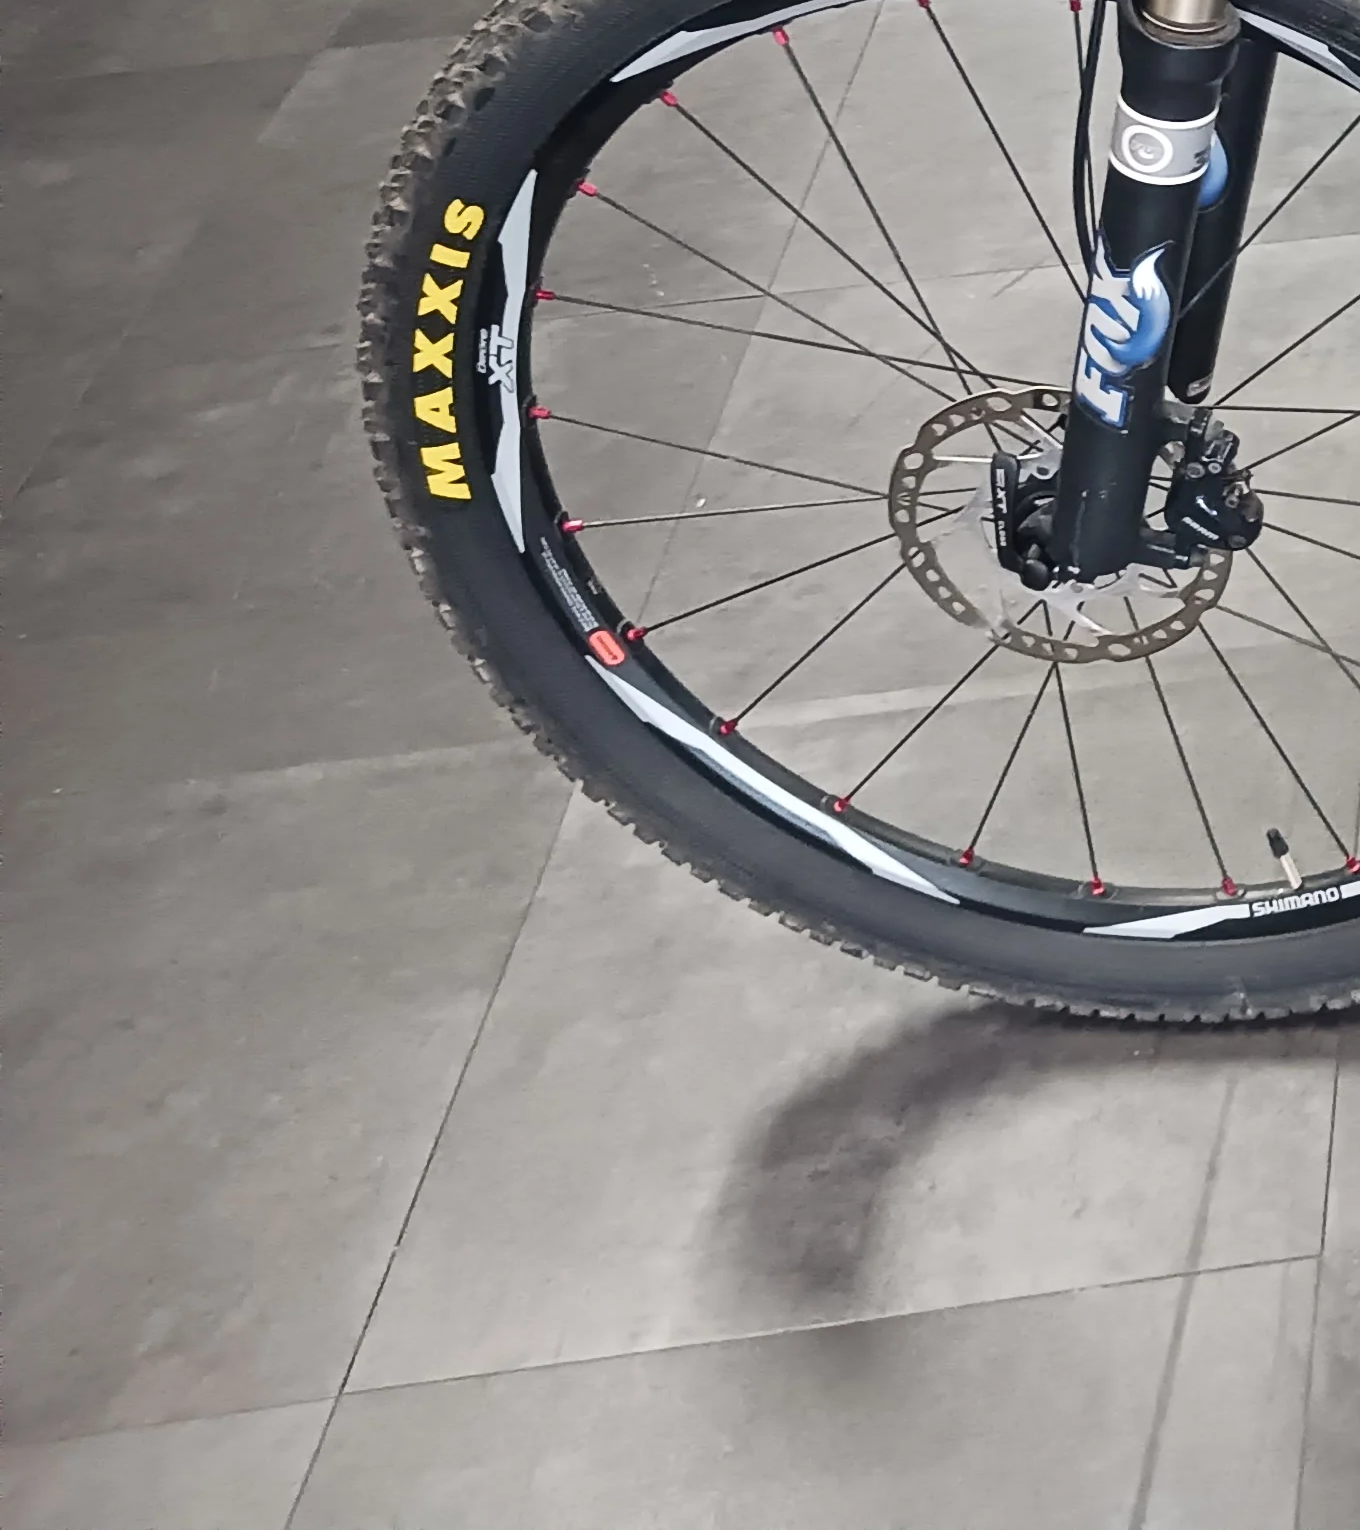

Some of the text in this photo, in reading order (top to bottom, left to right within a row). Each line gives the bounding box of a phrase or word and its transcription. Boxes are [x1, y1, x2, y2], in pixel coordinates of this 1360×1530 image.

[412, 198, 486, 501] MAXXIS
[487, 323, 515, 394] XT
[1075, 235, 1172, 428] FOX
[1251, 886, 1341, 919] SHIMANO
